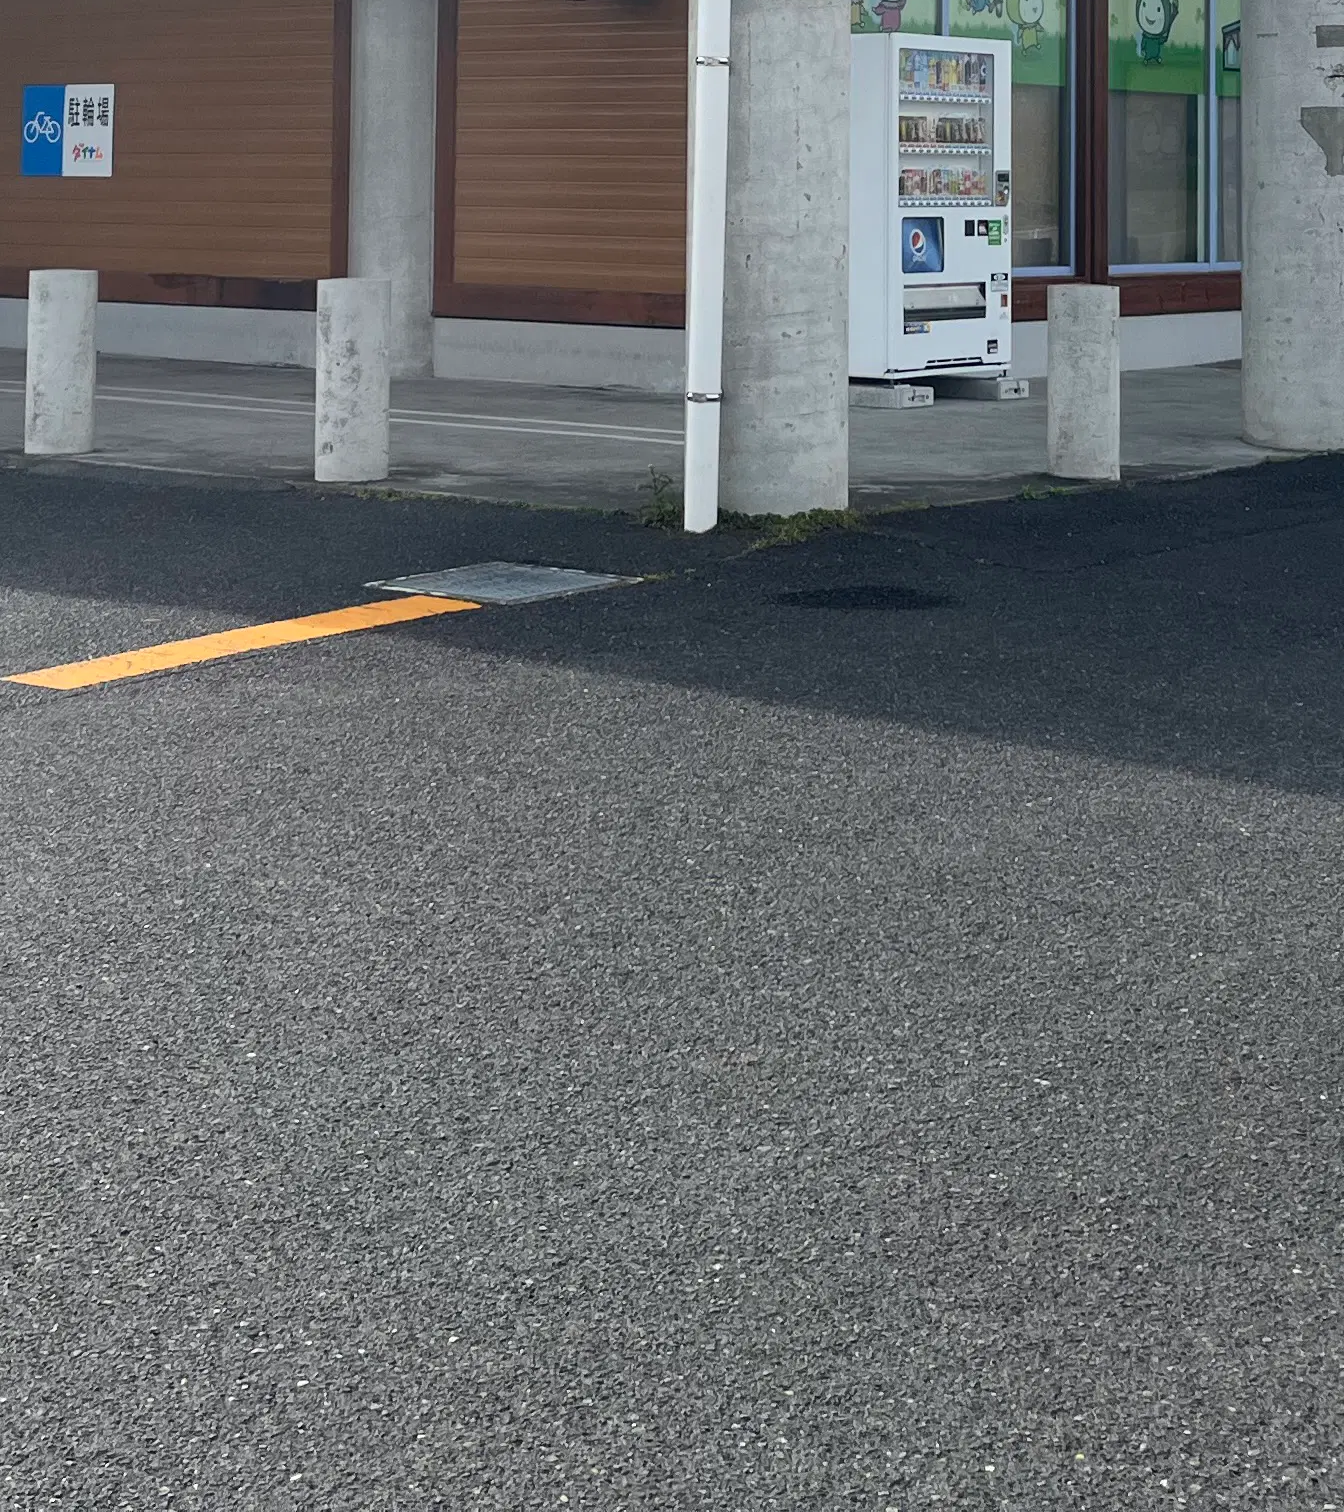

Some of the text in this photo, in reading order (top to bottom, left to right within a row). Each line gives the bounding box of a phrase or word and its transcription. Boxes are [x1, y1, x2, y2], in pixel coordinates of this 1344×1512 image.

[68, 96, 109, 127] 駐輪場
[72, 143, 103, 162] ダイナム
